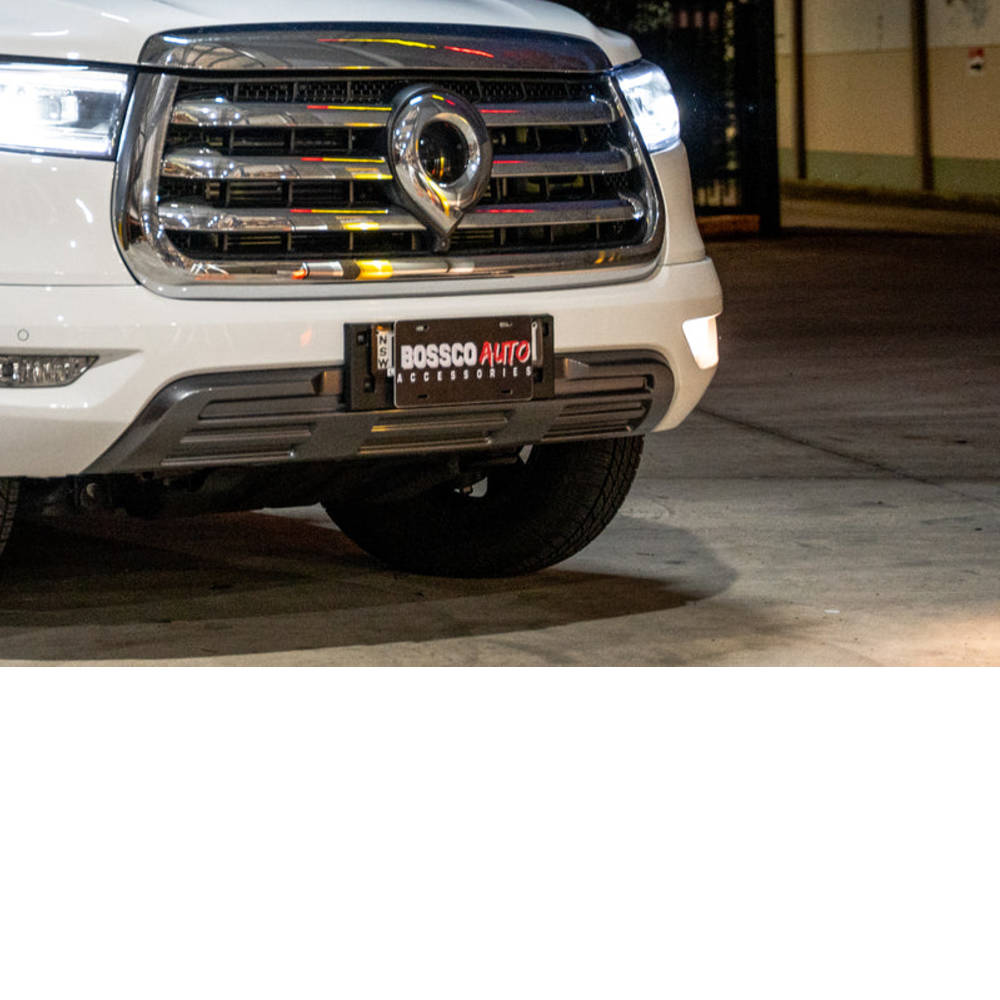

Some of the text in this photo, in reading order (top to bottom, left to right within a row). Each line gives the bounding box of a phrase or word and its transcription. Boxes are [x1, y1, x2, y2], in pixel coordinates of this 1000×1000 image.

[377, 335, 389, 369] NSW
[401, 339, 531, 369] BOSSCO AUTO
[396, 367, 532, 384] ACCESSORIES
